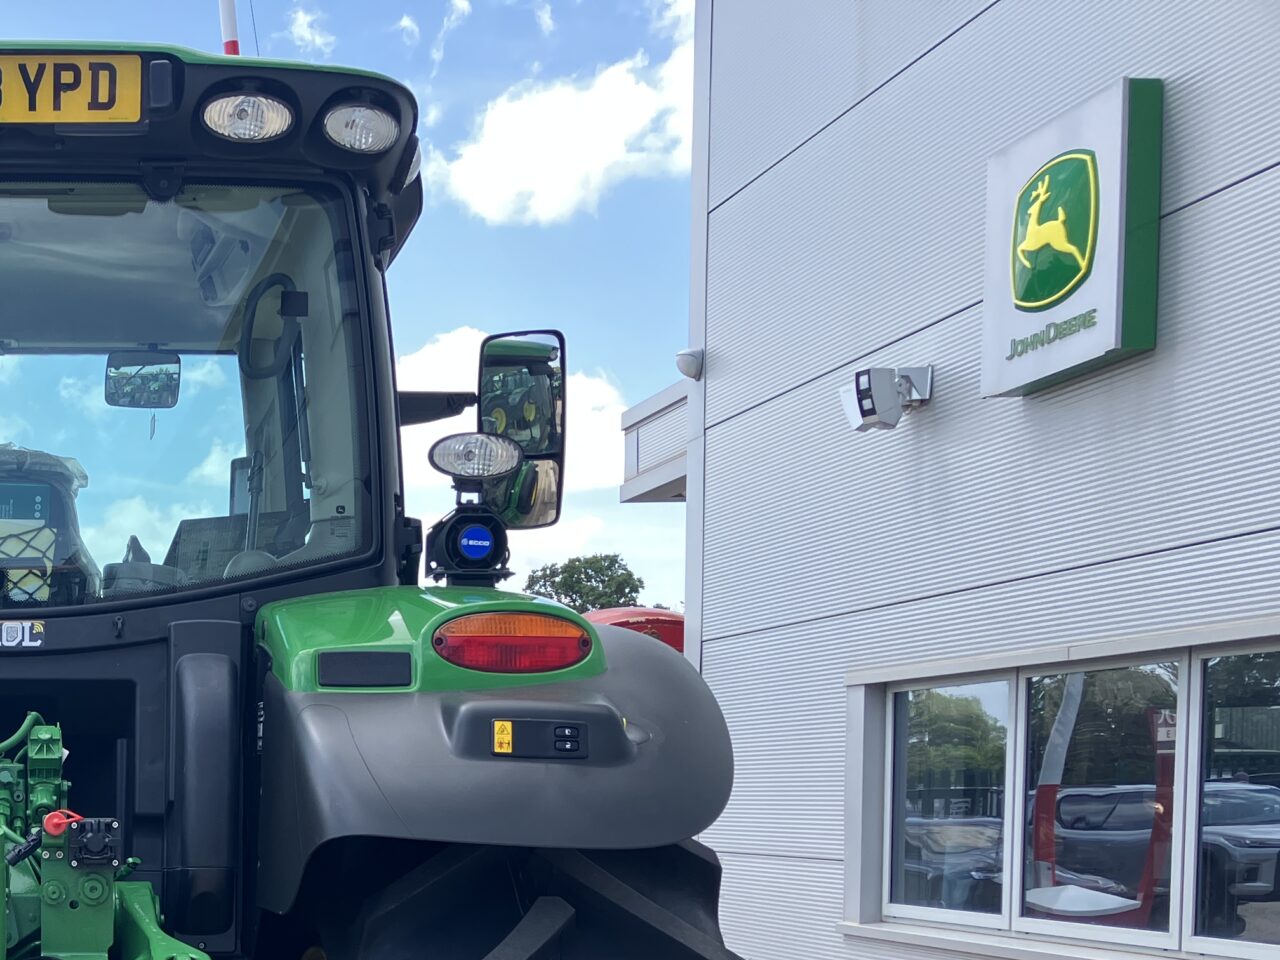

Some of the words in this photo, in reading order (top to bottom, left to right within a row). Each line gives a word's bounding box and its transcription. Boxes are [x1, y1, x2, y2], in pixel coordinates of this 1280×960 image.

[18, 62, 117, 112] YPD
[1005, 330, 1046, 361] JOHN
[1045, 308, 1098, 344] DEERE
